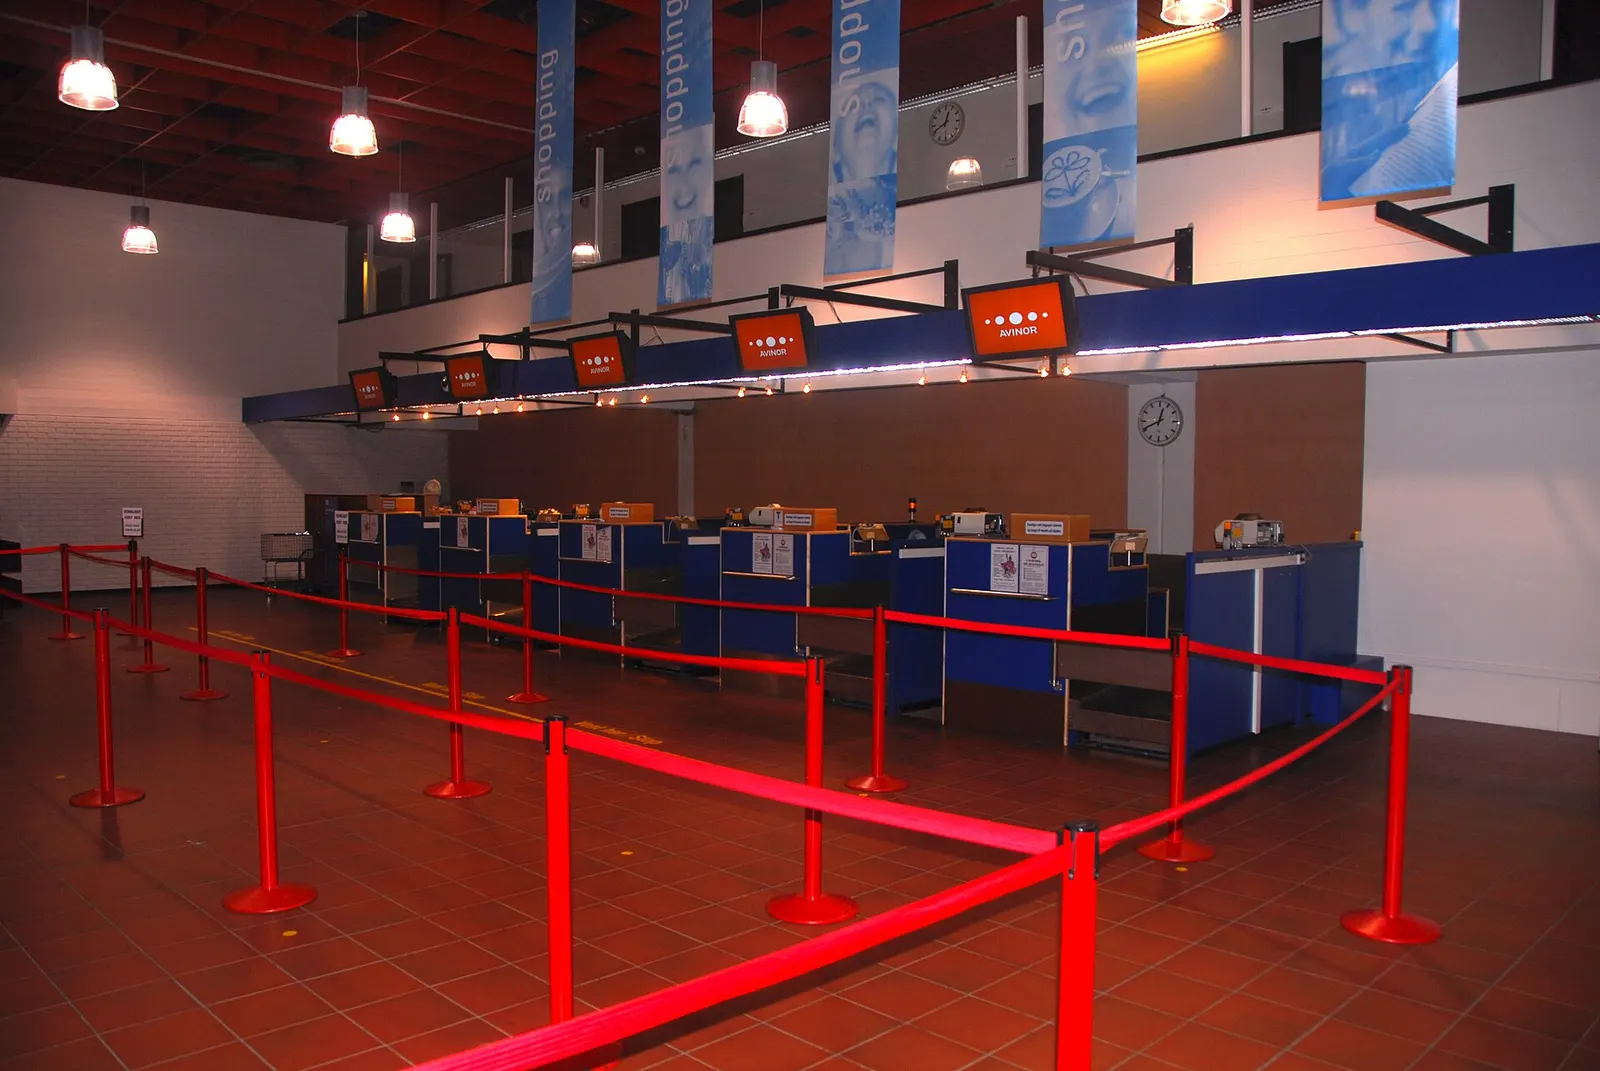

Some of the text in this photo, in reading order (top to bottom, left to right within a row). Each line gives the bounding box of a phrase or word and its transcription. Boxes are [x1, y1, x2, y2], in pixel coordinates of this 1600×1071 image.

[1049, 0, 1086, 63] sh
[537, 48, 559, 204] shopping
[999, 325, 1038, 338] AVINOR
[759, 348, 788, 359] AVINOR
[590, 365, 611, 375] AVINOR
